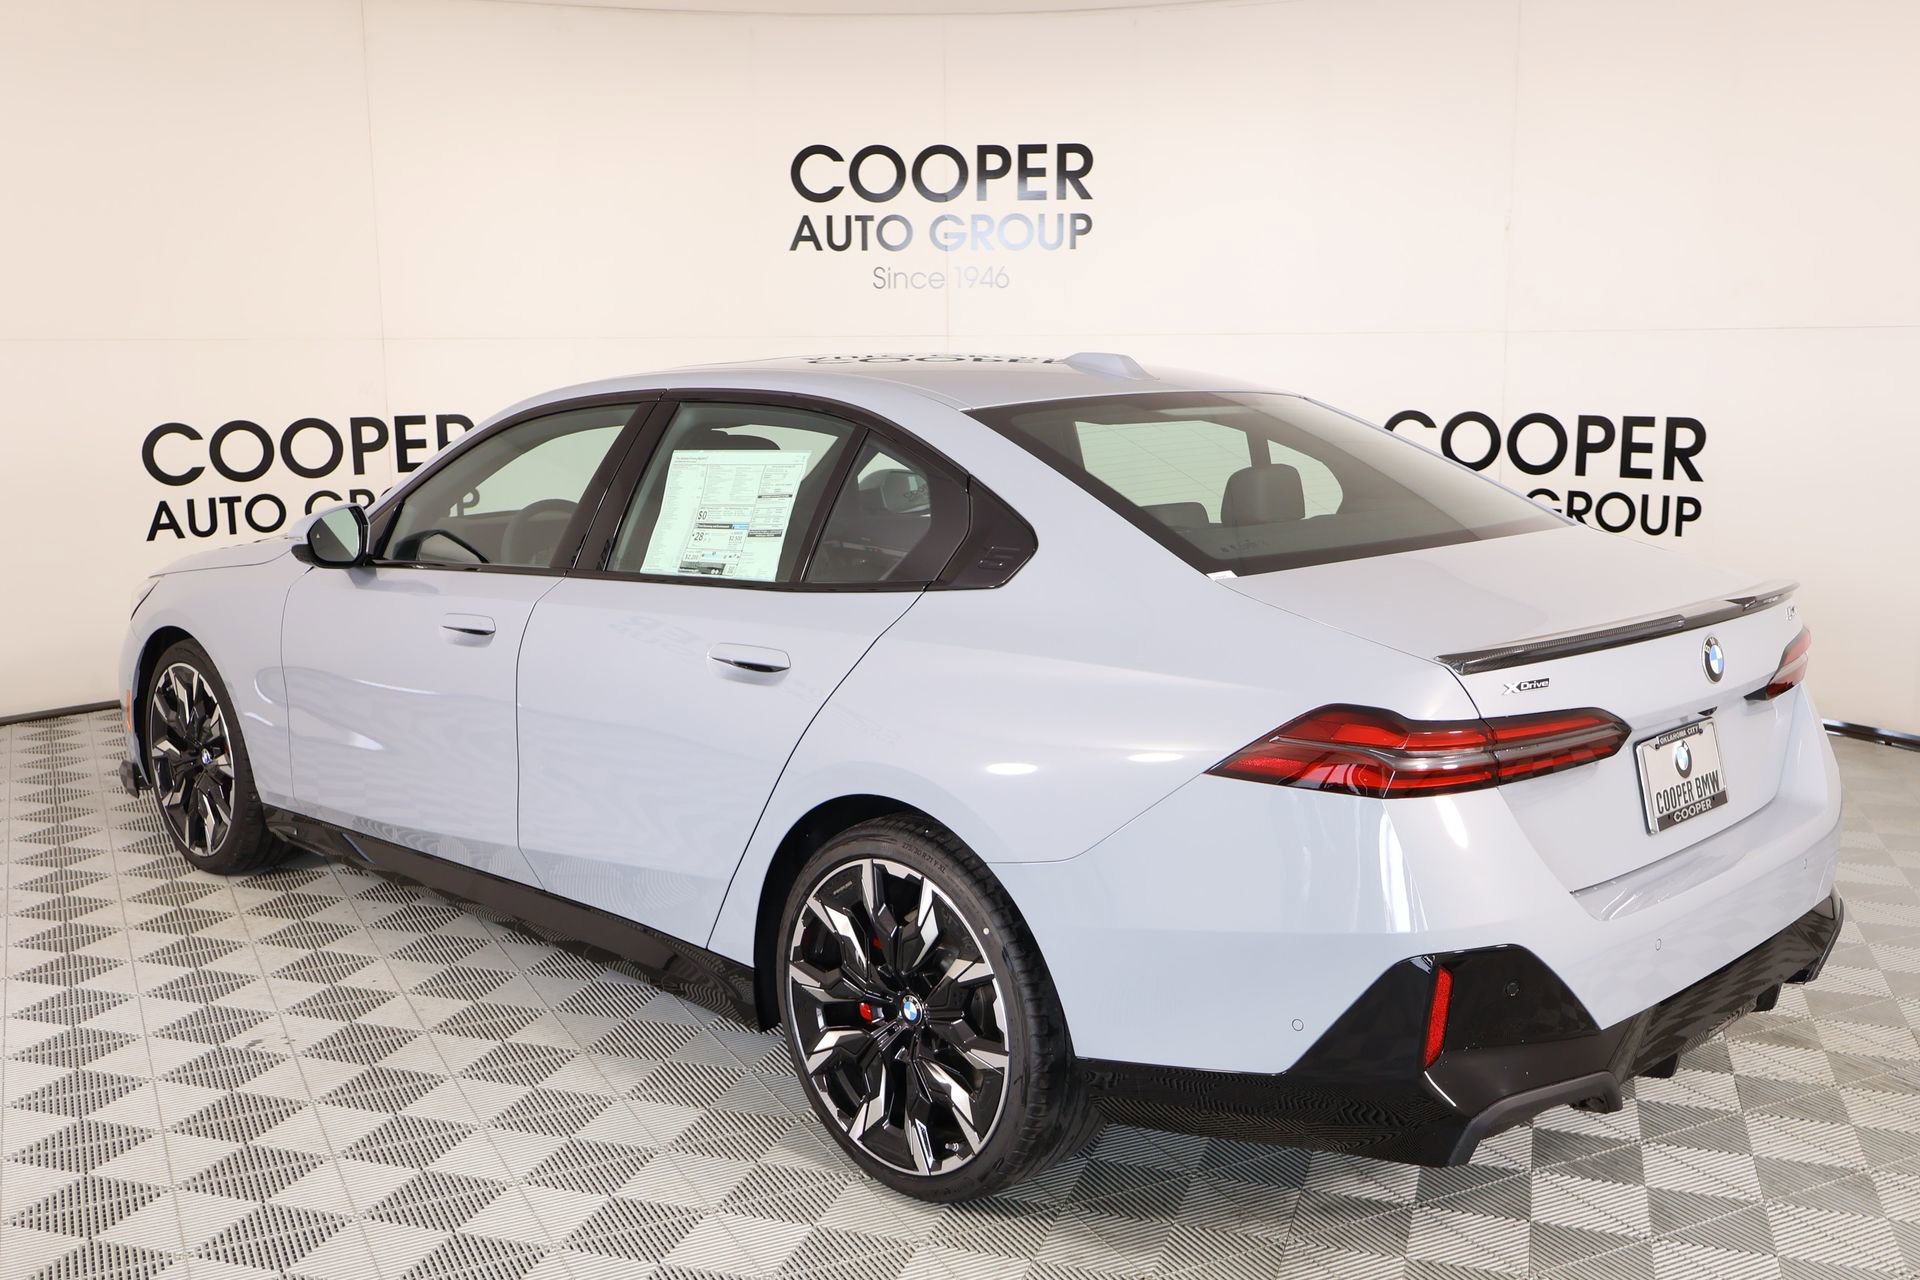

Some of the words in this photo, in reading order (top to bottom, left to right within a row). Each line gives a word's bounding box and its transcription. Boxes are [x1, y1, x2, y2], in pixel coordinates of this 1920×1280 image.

[790, 143, 1094, 203] COOPER
[789, 214, 914, 252] AUTO
[929, 213, 1093, 252] GROUP
[872, 266, 945, 289] Since
[953, 265, 1010, 289] 1946
[146, 493, 287, 542] AUTO
[1687, 725, 1699, 735] CITY
[1655, 780, 1695, 814] COOPER
[1695, 770, 1720, 798] BMW
[1673, 798, 1713, 822] COOPER
